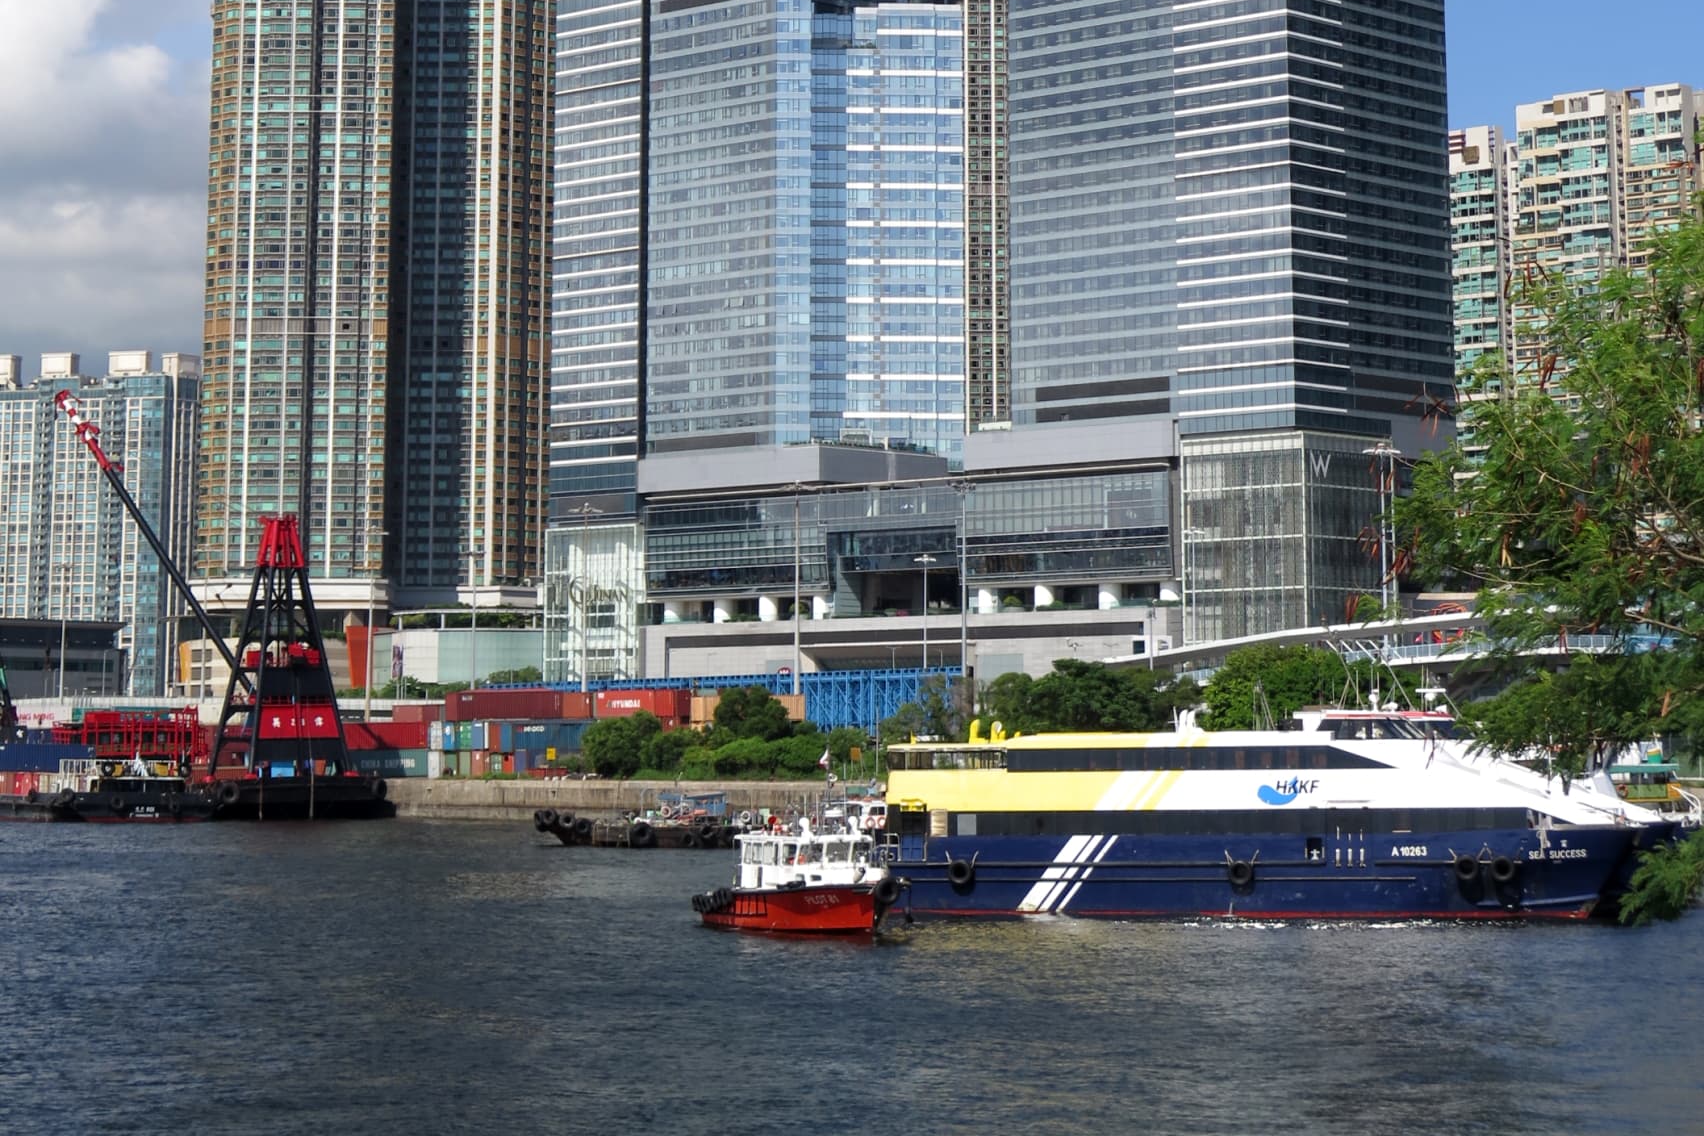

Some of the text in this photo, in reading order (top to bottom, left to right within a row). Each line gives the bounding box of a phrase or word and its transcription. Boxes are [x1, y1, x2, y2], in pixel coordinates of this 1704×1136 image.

[1311, 451, 1331, 478] W
[1276, 780, 1320, 794] HKKF
[1391, 846, 1427, 857] A 10263
[1528, 849, 1588, 859] SEA SUCCESS
